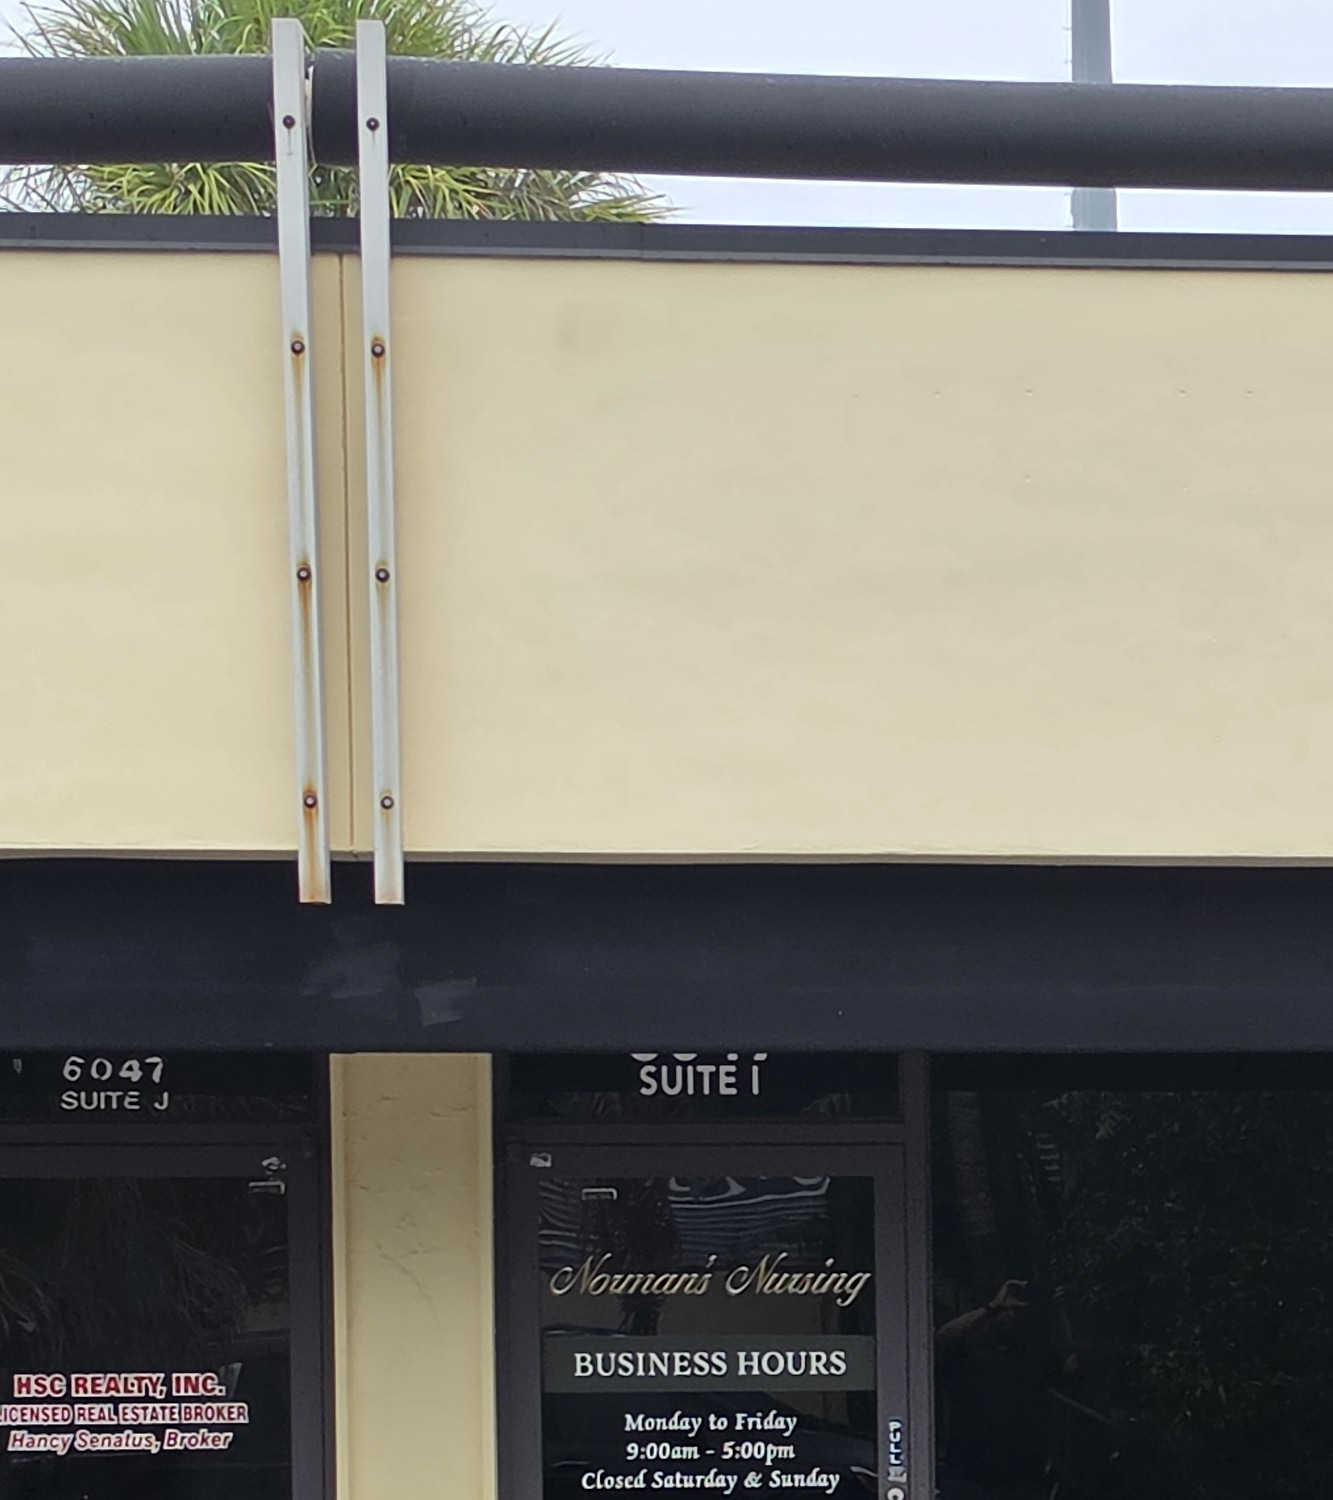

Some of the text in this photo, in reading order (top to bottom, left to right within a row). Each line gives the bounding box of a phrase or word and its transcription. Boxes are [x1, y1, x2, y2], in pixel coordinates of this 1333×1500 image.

[62, 1056, 164, 1084] 6047
[639, 1065, 761, 1096] SUITE I
[60, 1091, 169, 1110] SUITE J
[726, 1252, 871, 1305] Nursing
[574, 1350, 847, 1377] BUSINESS HOURS
[14, 1373, 226, 1399] HSC REALTY, INC.
[75, 1404, 117, 1424] REAL
[119, 1403, 179, 1423] ESTATE
[181, 1403, 248, 1423] BROKER
[624, 1409, 797, 1437] Monday to Friday
[164, 1429, 233, 1450] Broker
[625, 1442, 700, 1460] 9:00am
[721, 1441, 796, 1465] 5:00pm
[888, 1421, 902, 1465] PULL
[581, 1467, 840, 1494] Closed Saturday & Sunday
